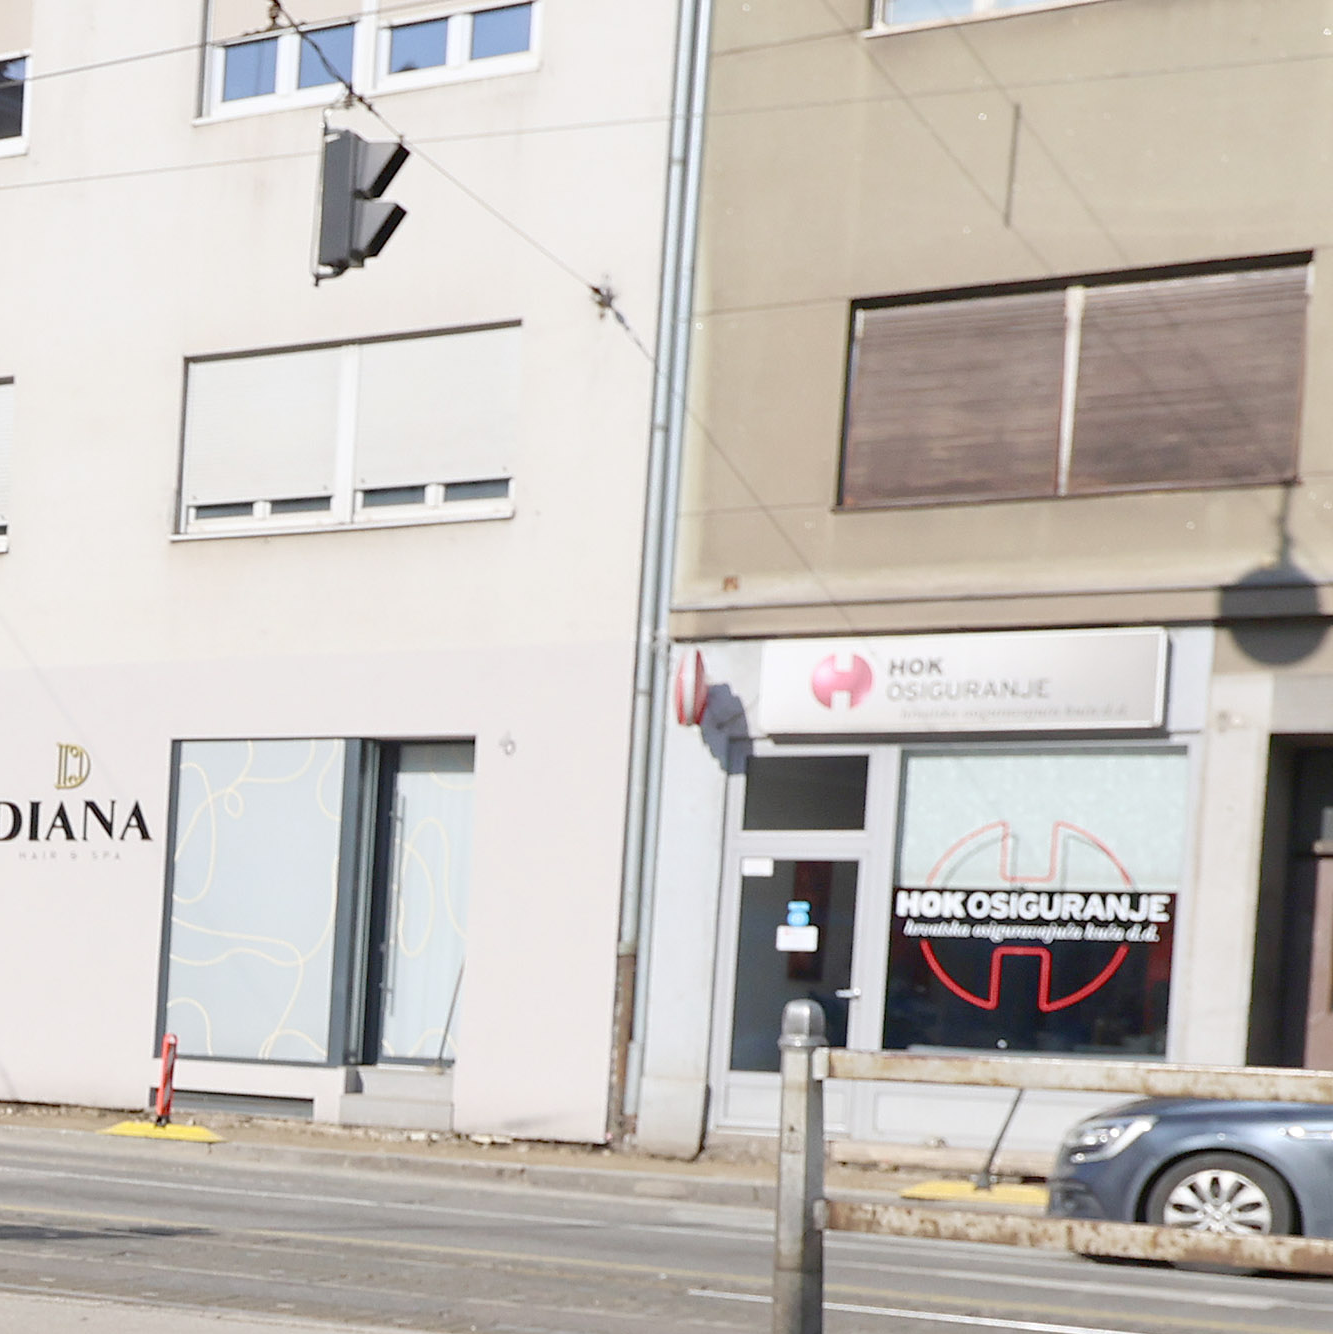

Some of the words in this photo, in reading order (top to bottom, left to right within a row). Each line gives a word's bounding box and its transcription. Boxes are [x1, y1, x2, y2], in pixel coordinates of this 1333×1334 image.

[889, 657, 944, 676] HOK
[887, 677, 1053, 701] OSIGURANJE
[18, 850, 58, 861] HAIR
[91, 850, 122, 861] SPA
[895, 889, 966, 919] HOK
[967, 891, 1172, 923] OSIGURANJE
